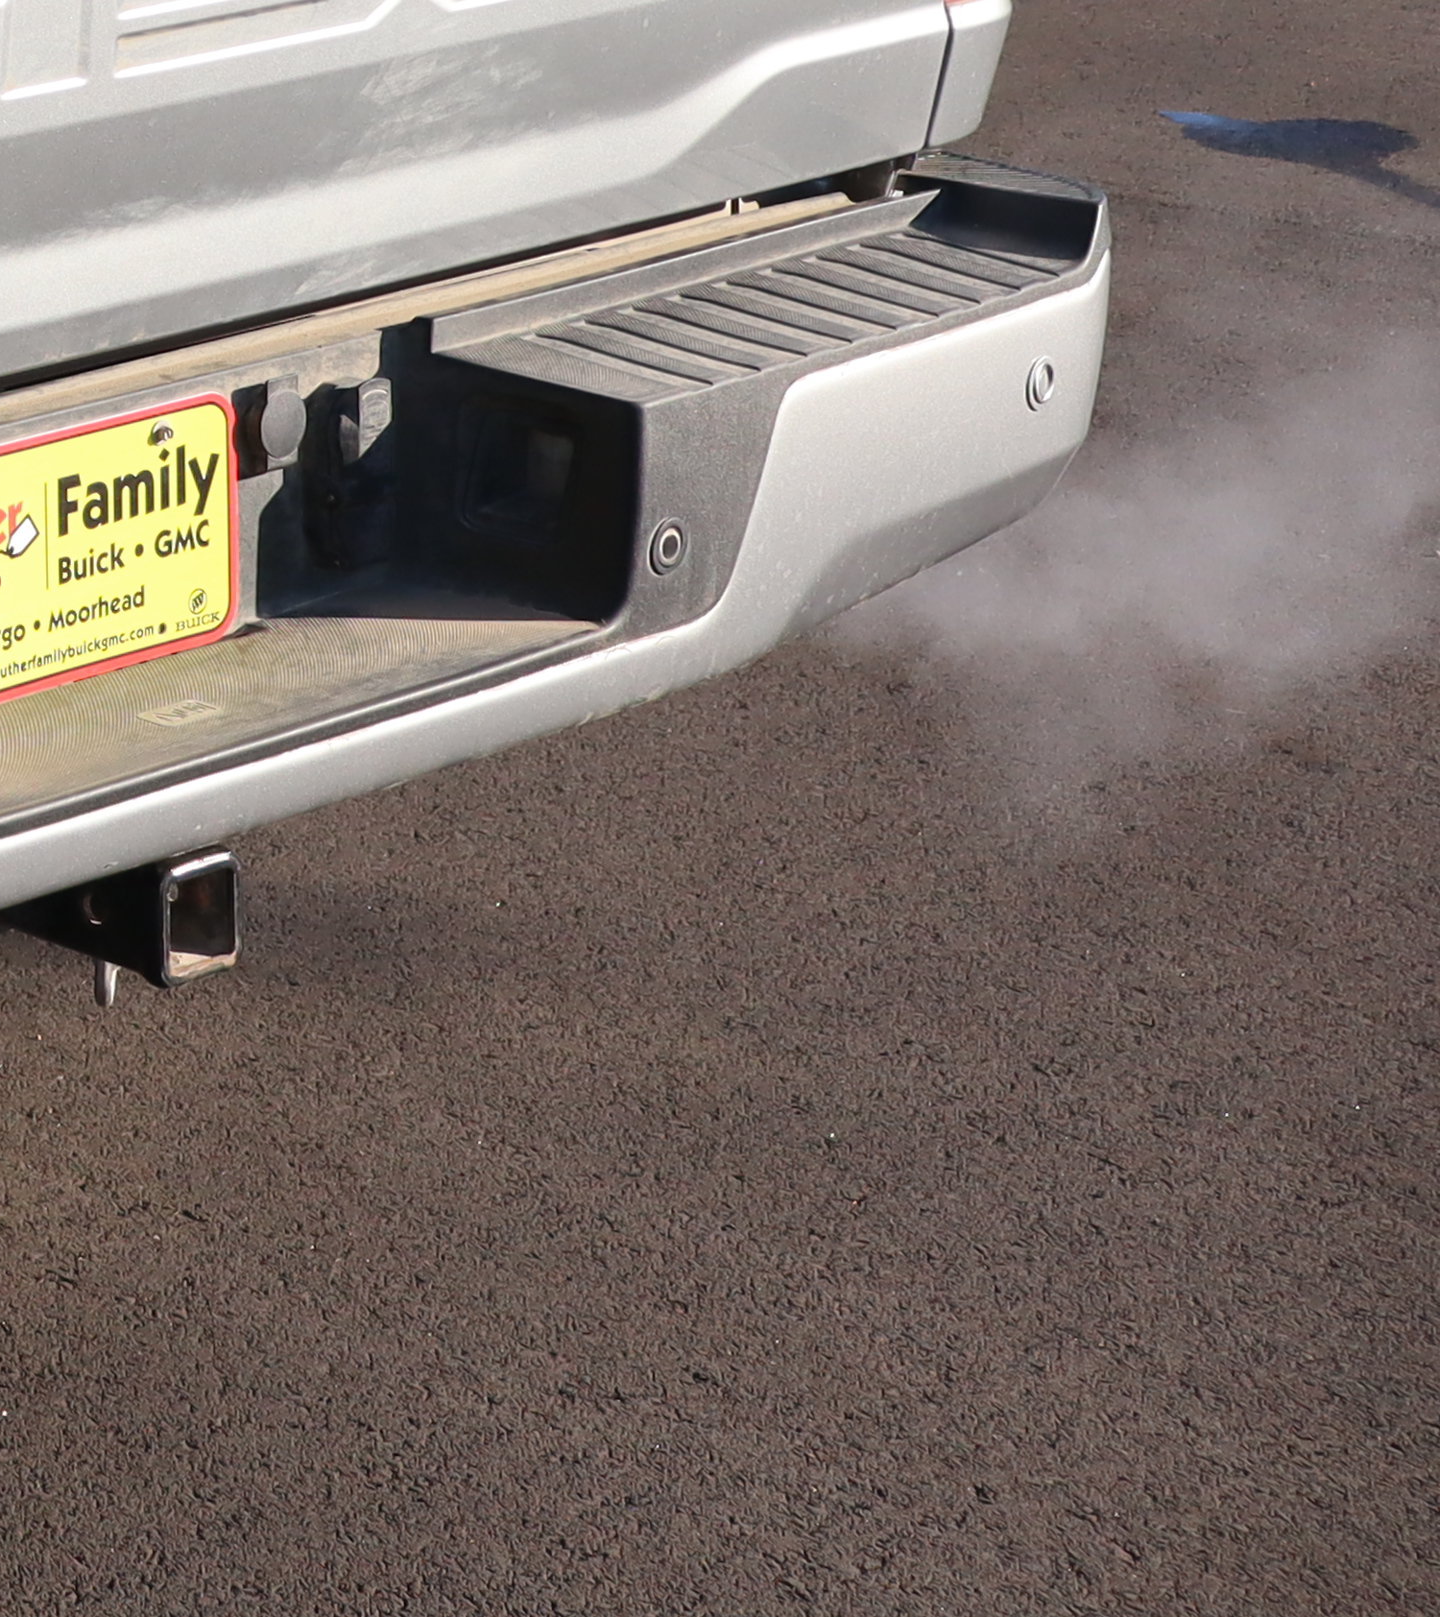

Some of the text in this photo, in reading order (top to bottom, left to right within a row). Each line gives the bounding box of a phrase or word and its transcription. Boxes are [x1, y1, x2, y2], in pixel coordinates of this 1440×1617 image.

[57, 444, 220, 537] Family
[58, 519, 210, 585] Buick GMC
[47, 584, 145, 633] Moorhead
[175, 611, 221, 633] BUICK
